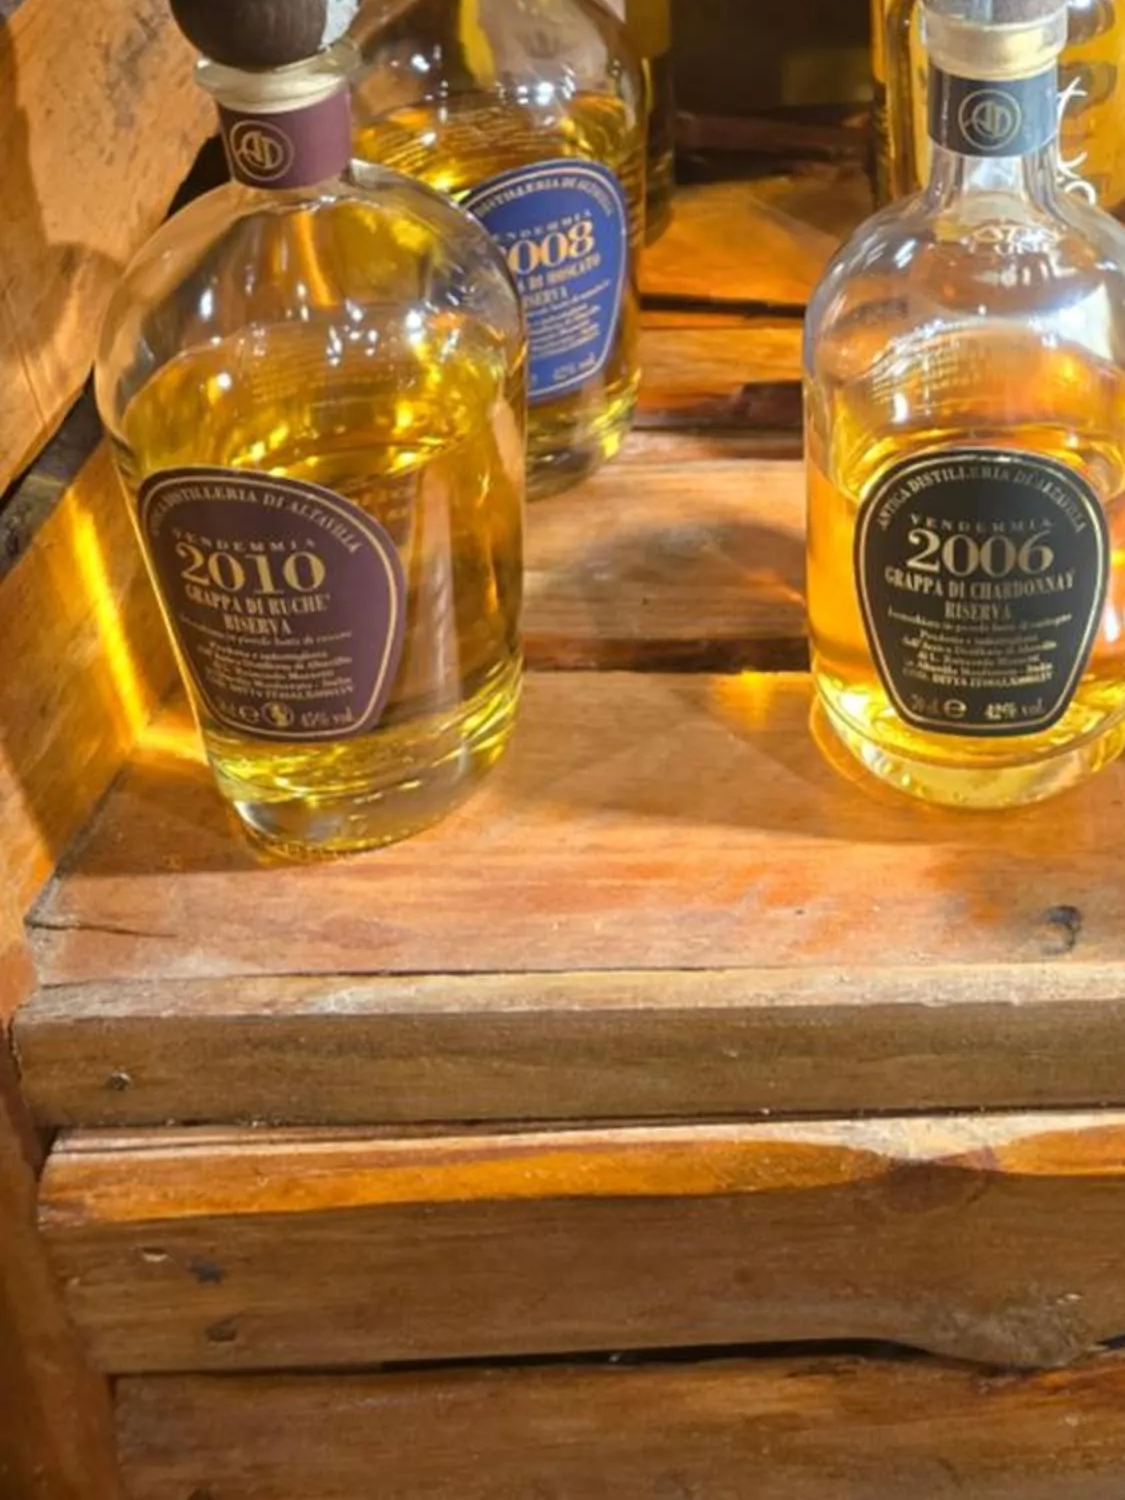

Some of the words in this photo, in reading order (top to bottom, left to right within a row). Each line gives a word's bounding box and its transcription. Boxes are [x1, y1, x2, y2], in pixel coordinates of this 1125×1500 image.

[499, 220, 597, 275] 008
[906, 466, 1009, 492] DISTILLERIA
[175, 541, 326, 595] 2010
[906, 527, 1055, 578] 2006
[184, 583, 243, 614] GRAPPA
[245, 596, 263, 616] DI
[884, 566, 944, 598] GRAPPA
[948, 578, 968, 600] DI
[969, 571, 1076, 601] CHARDONNAY
[222, 613, 293, 635] RISERVA
[944, 599, 1012, 620] RISERVA
